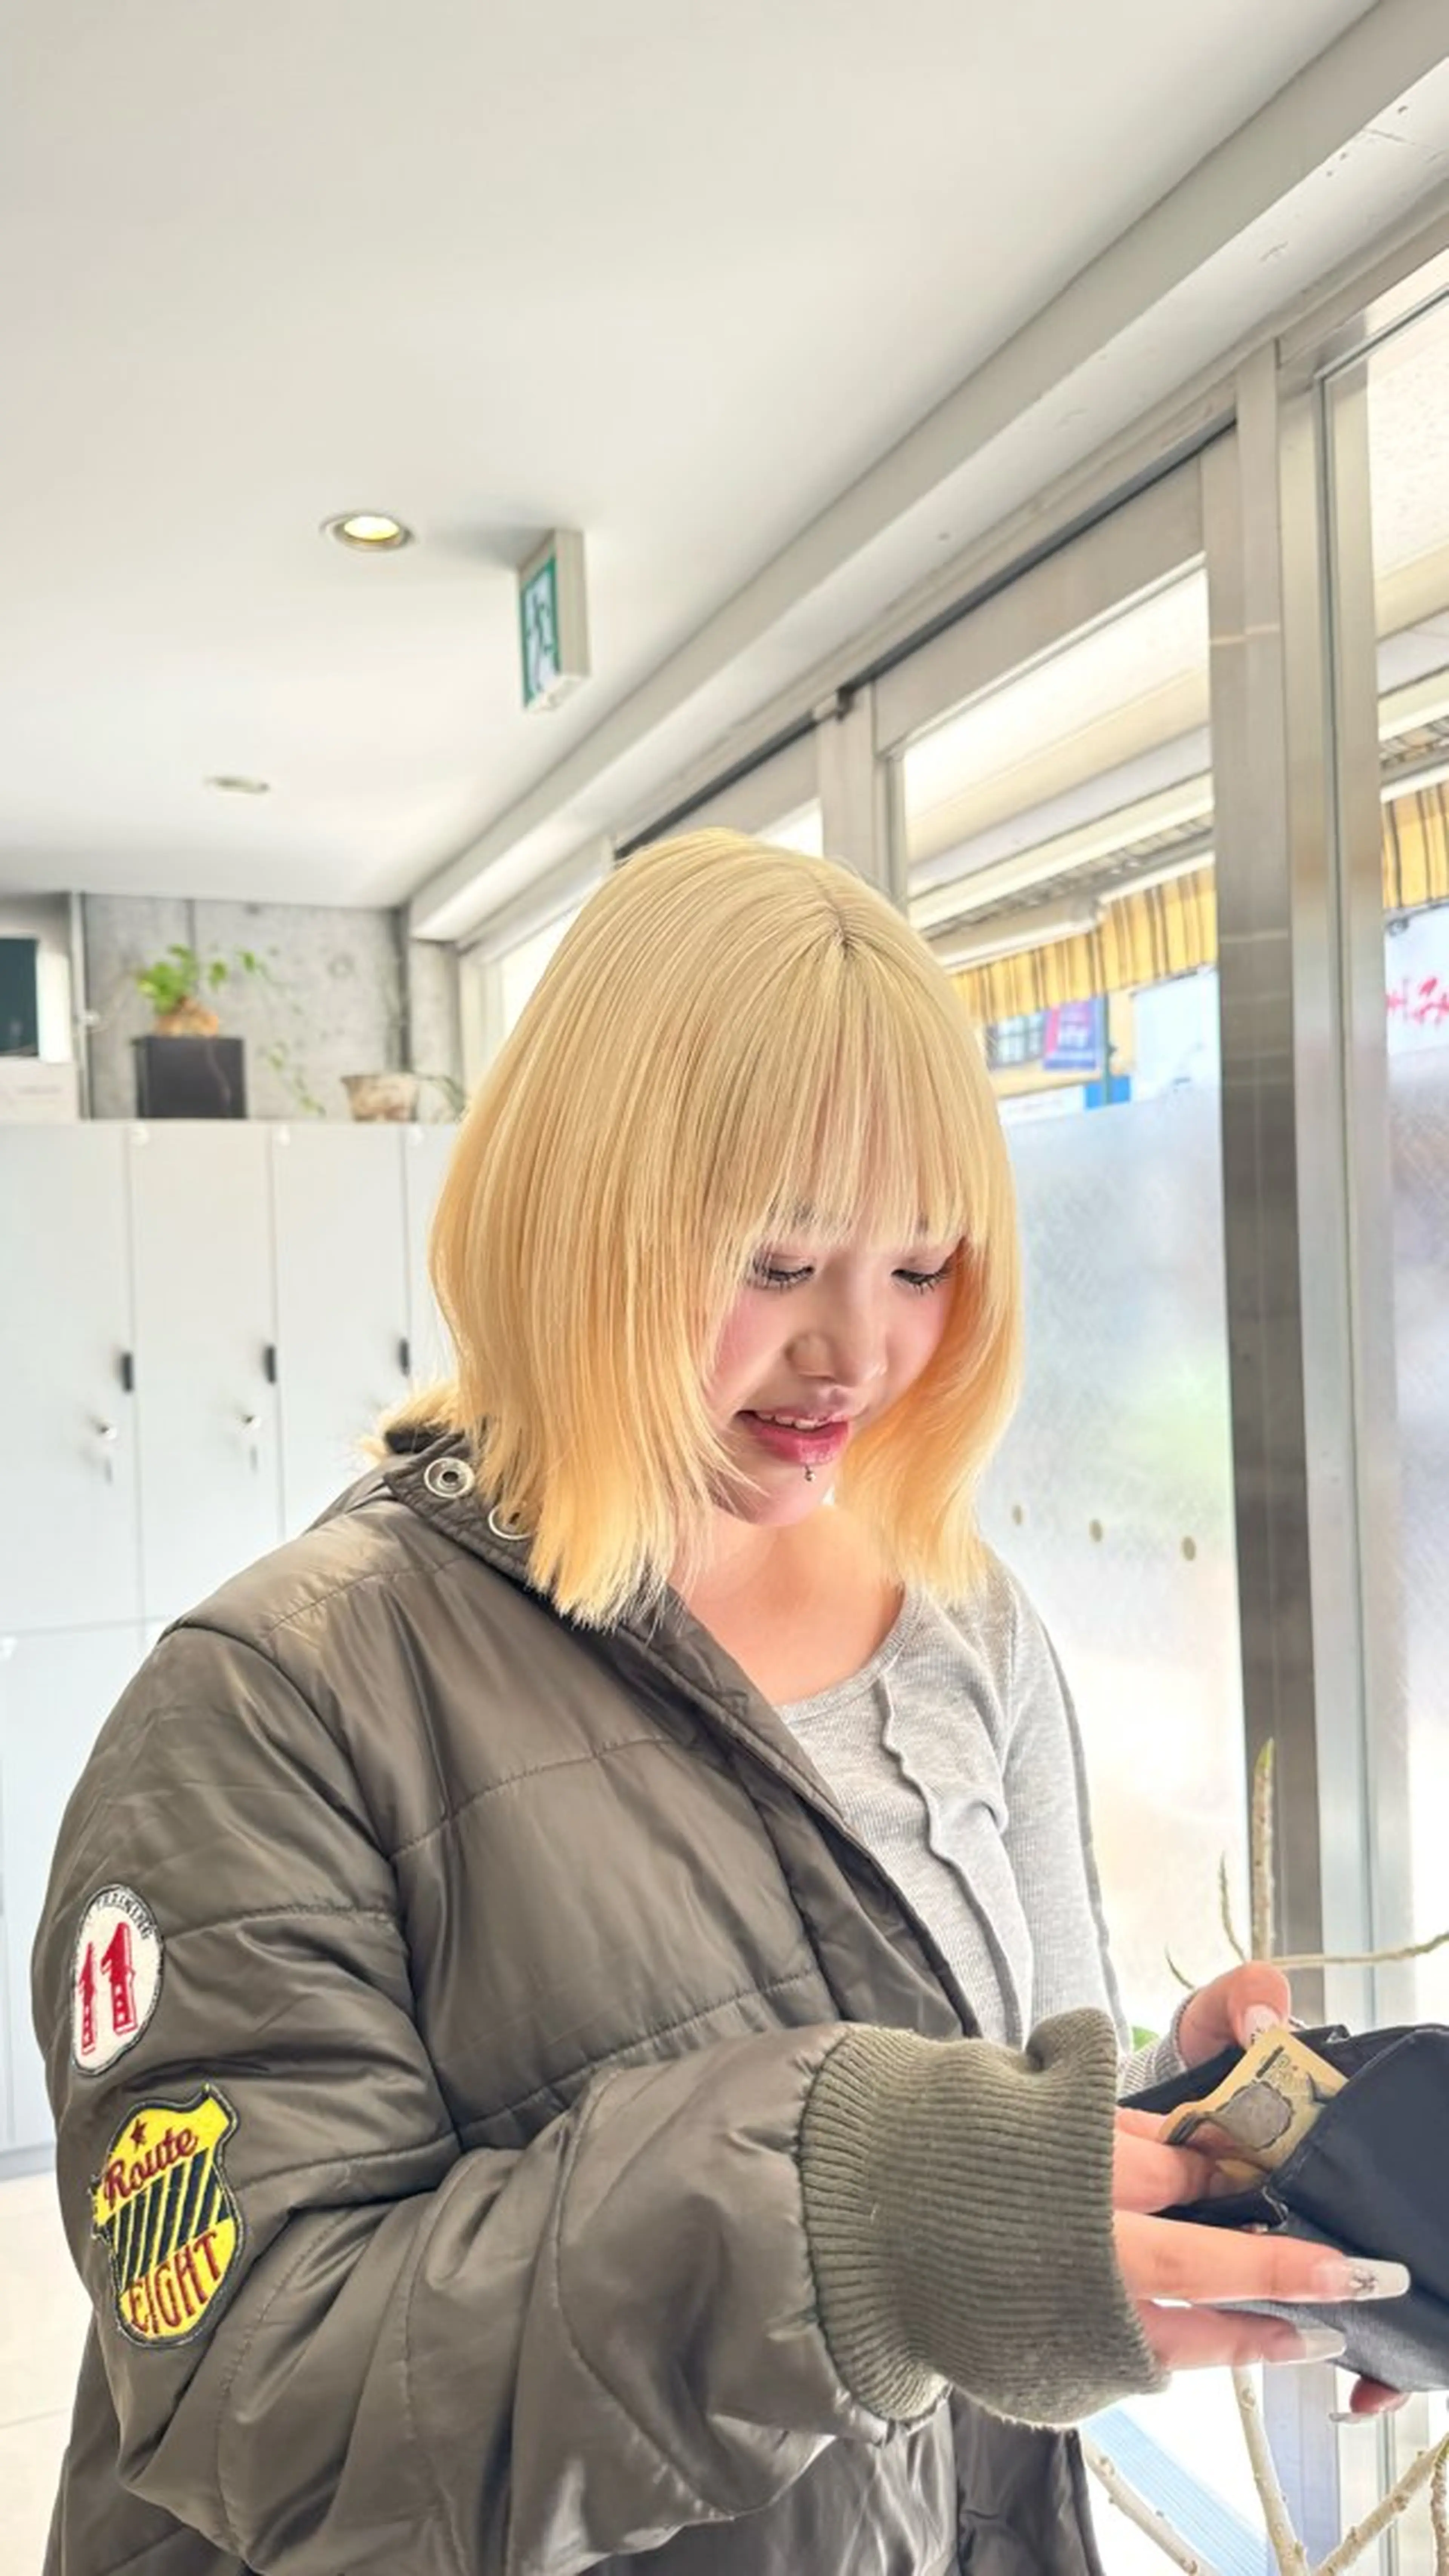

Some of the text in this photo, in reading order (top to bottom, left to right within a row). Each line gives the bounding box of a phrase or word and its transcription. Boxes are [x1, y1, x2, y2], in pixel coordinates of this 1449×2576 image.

[79, 1922, 138, 2055] 11
[104, 2127, 198, 2212] Route
[128, 2230, 221, 2333] EIGHT
